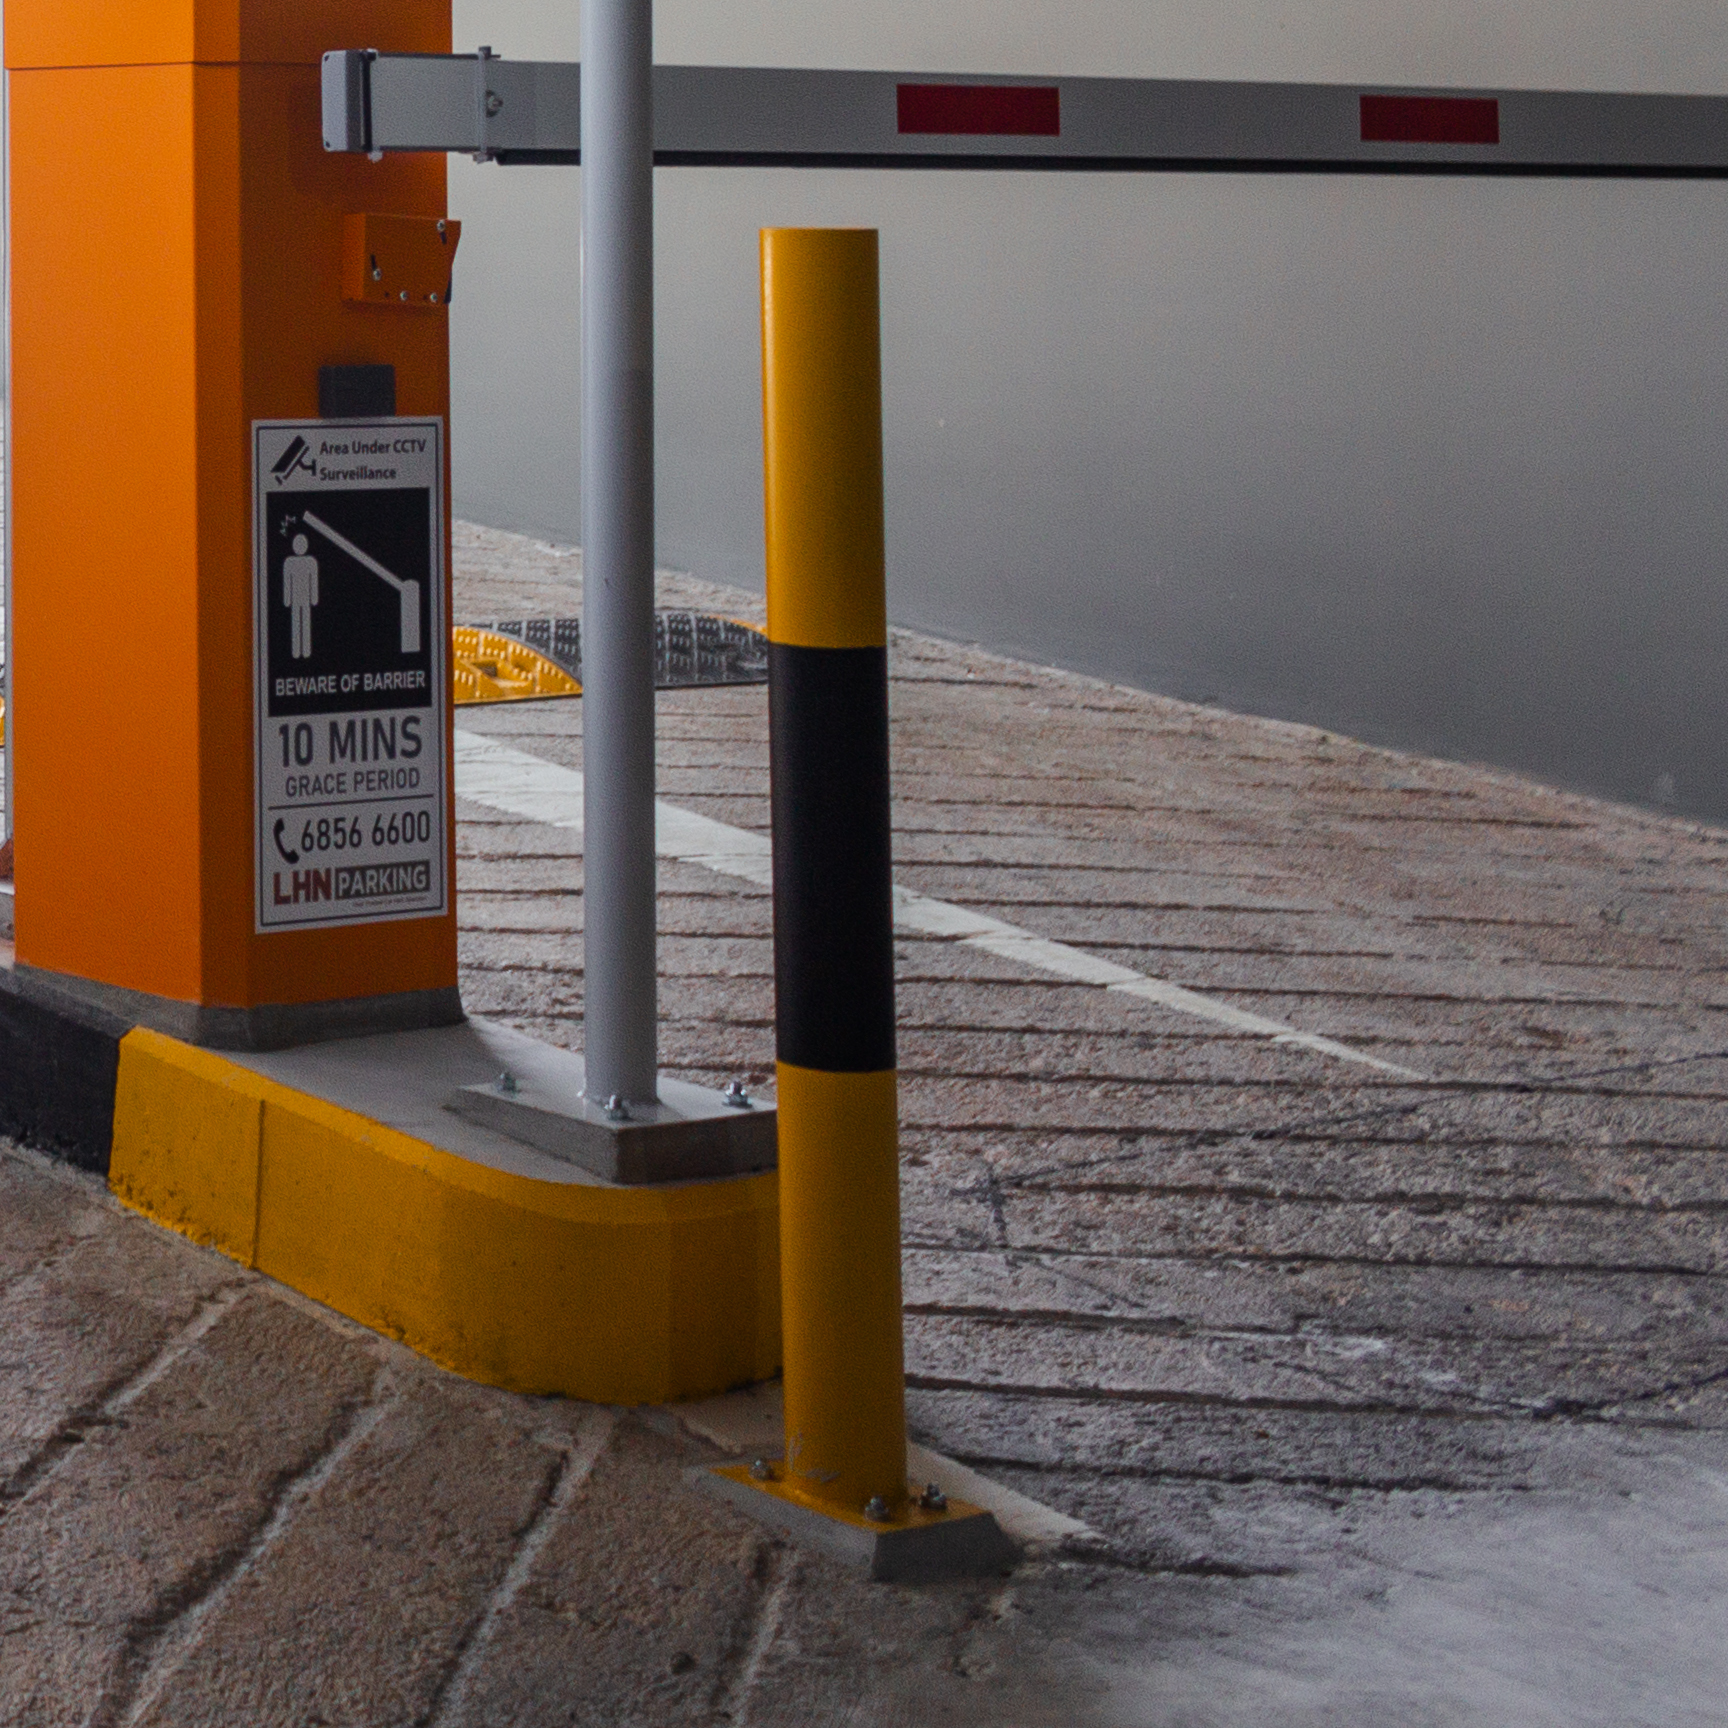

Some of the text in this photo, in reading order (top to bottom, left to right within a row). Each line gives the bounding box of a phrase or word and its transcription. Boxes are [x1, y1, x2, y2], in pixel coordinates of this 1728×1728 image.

[320, 438, 427, 455] Area Under CCTV
[320, 467, 397, 481] Surveillance
[275, 670, 426, 697] BEWARE OF BARRIER
[278, 715, 423, 768] 10 MINS
[285, 767, 420, 798] GRACE PERIOD
[301, 810, 431, 853] 6856 6600
[273, 863, 427, 907] LHN PARKING
